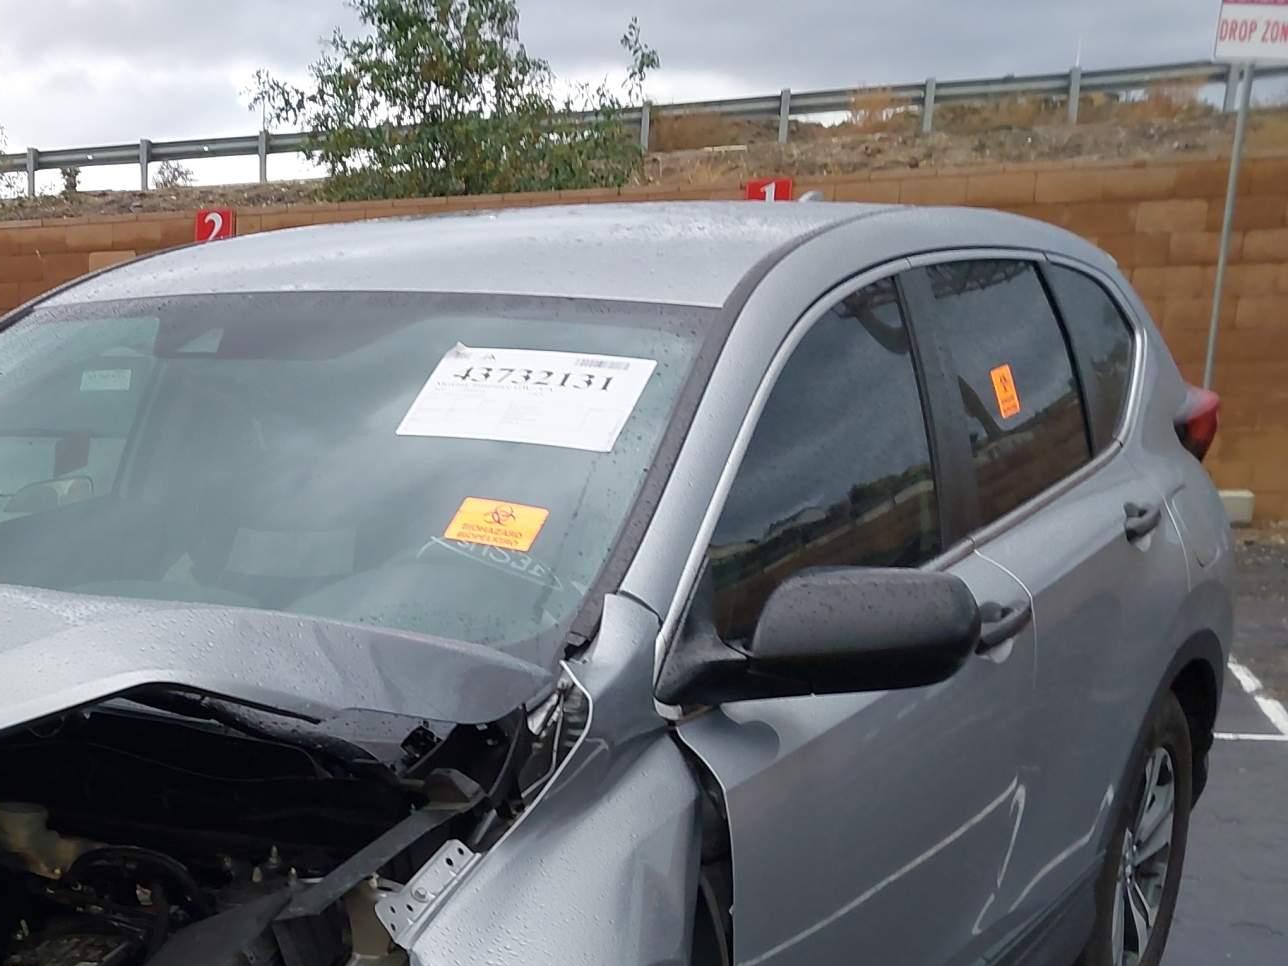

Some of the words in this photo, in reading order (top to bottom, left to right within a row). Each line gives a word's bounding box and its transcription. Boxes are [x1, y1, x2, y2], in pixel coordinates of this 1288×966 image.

[1219, 18, 1257, 42] DROP
[760, 181, 776, 201] 1
[204, 211, 223, 241] 2
[453, 365, 615, 392] 43732131
